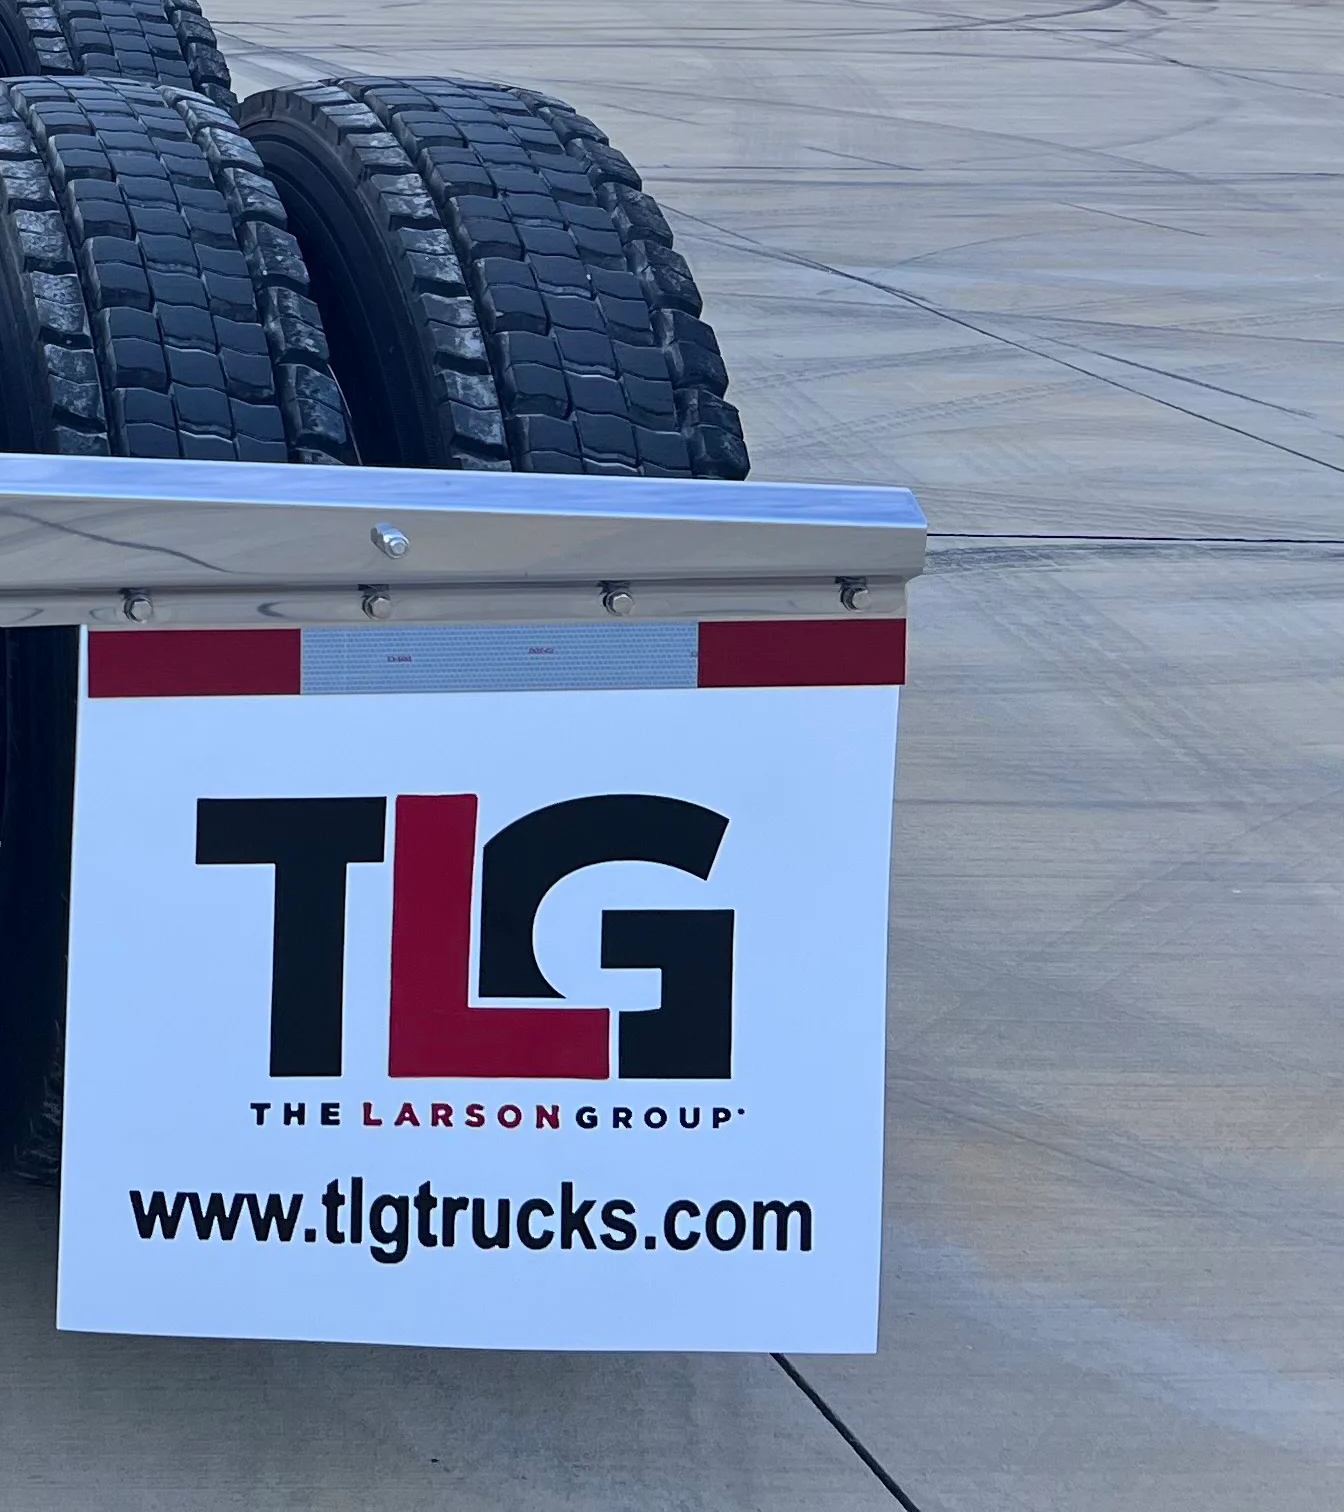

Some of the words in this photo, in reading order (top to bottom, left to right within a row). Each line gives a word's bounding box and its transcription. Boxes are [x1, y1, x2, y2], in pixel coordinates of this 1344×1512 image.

[195, 793, 736, 1081] TLG
[249, 1101, 341, 1127] THE
[362, 1101, 560, 1130] LARSON
[128, 1175, 813, 1265] www.tlgtrucks.com
